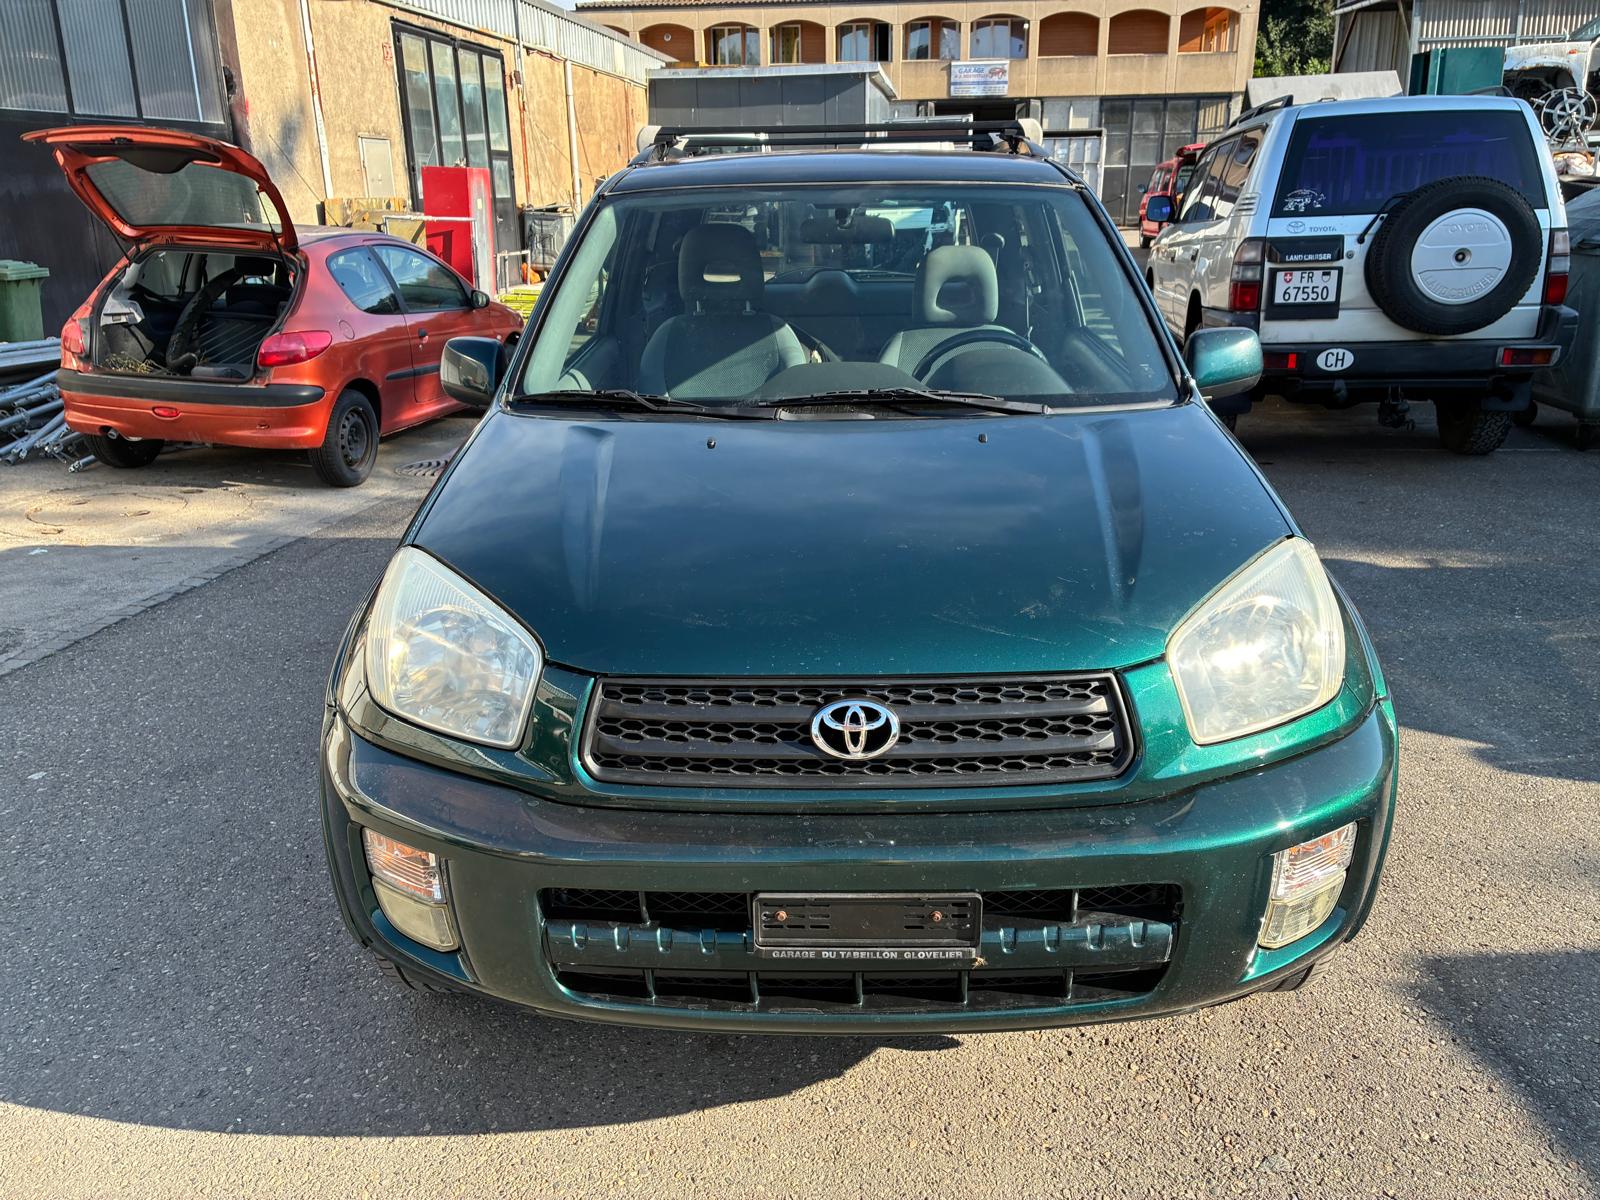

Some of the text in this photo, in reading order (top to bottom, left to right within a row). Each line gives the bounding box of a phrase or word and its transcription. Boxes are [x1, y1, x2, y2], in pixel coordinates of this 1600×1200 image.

[1441, 222, 1489, 233] TOYOTA
[1285, 253, 1332, 262] LAND CRUISER
[1300, 271, 1314, 284] FR
[1450, 273, 1496, 297] CRUISER
[1282, 286, 1330, 302] 67550
[1324, 351, 1346, 368] CH
[772, 950, 963, 959] GARAGE DU TABEILLON GLOVELIER
